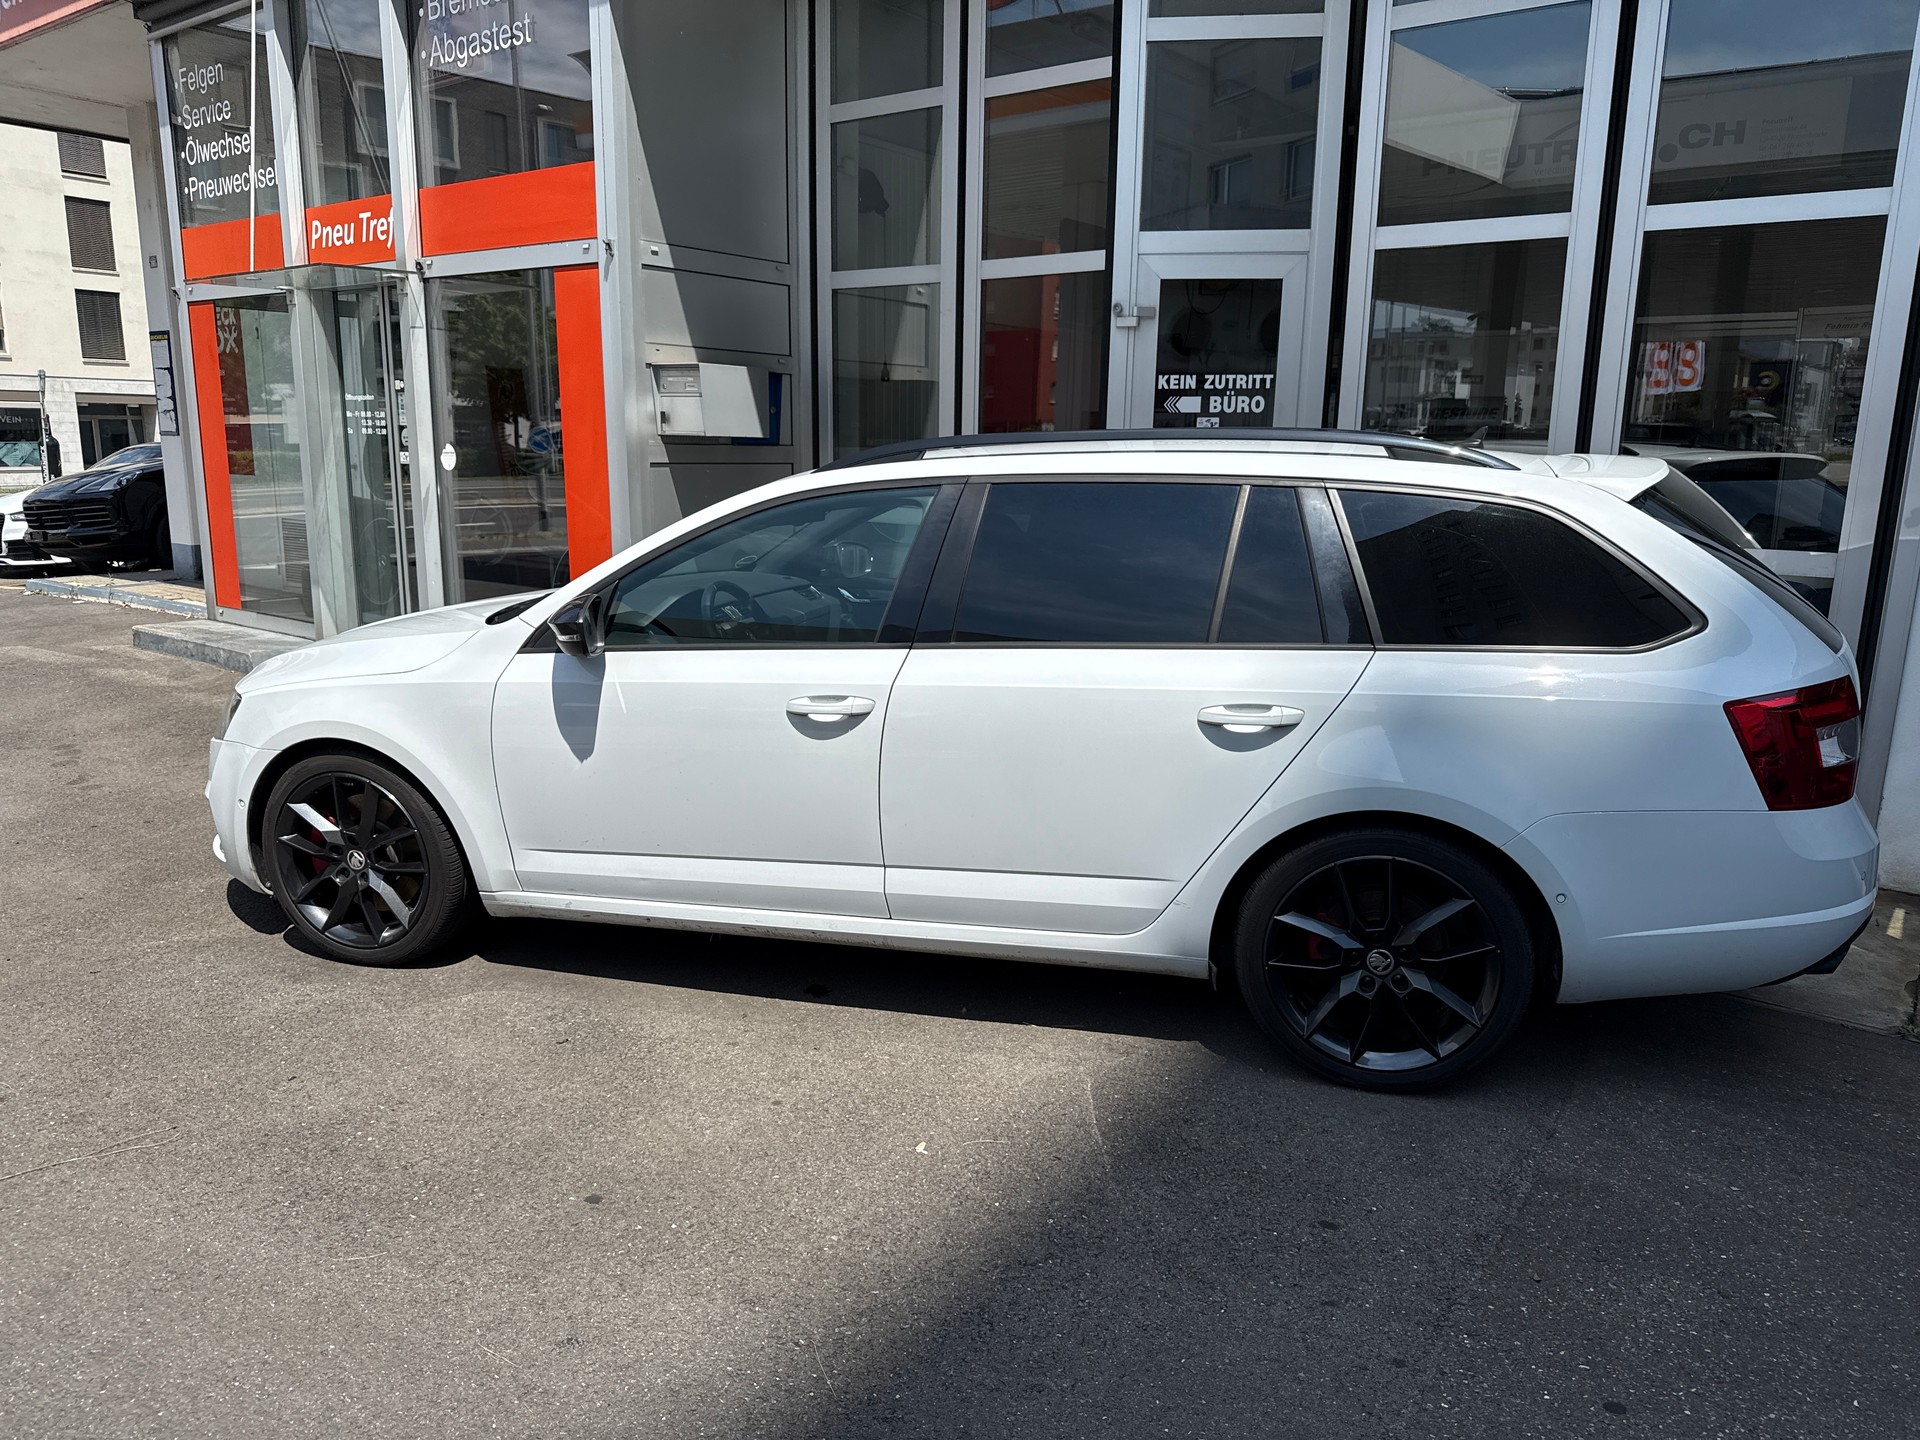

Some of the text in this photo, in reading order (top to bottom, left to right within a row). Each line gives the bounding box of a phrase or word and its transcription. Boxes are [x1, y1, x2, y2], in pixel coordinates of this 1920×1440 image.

[429, 12, 531, 68] Abgastest
[178, 62, 224, 94] Felgen
[182, 98, 231, 130] Service
[185, 131, 253, 166] Ölwechse
[311, 206, 395, 250] Pneu Tref
[1158, 374, 1274, 390] KEIN ZUTRITT
[1209, 391, 1265, 414] BÜRO
